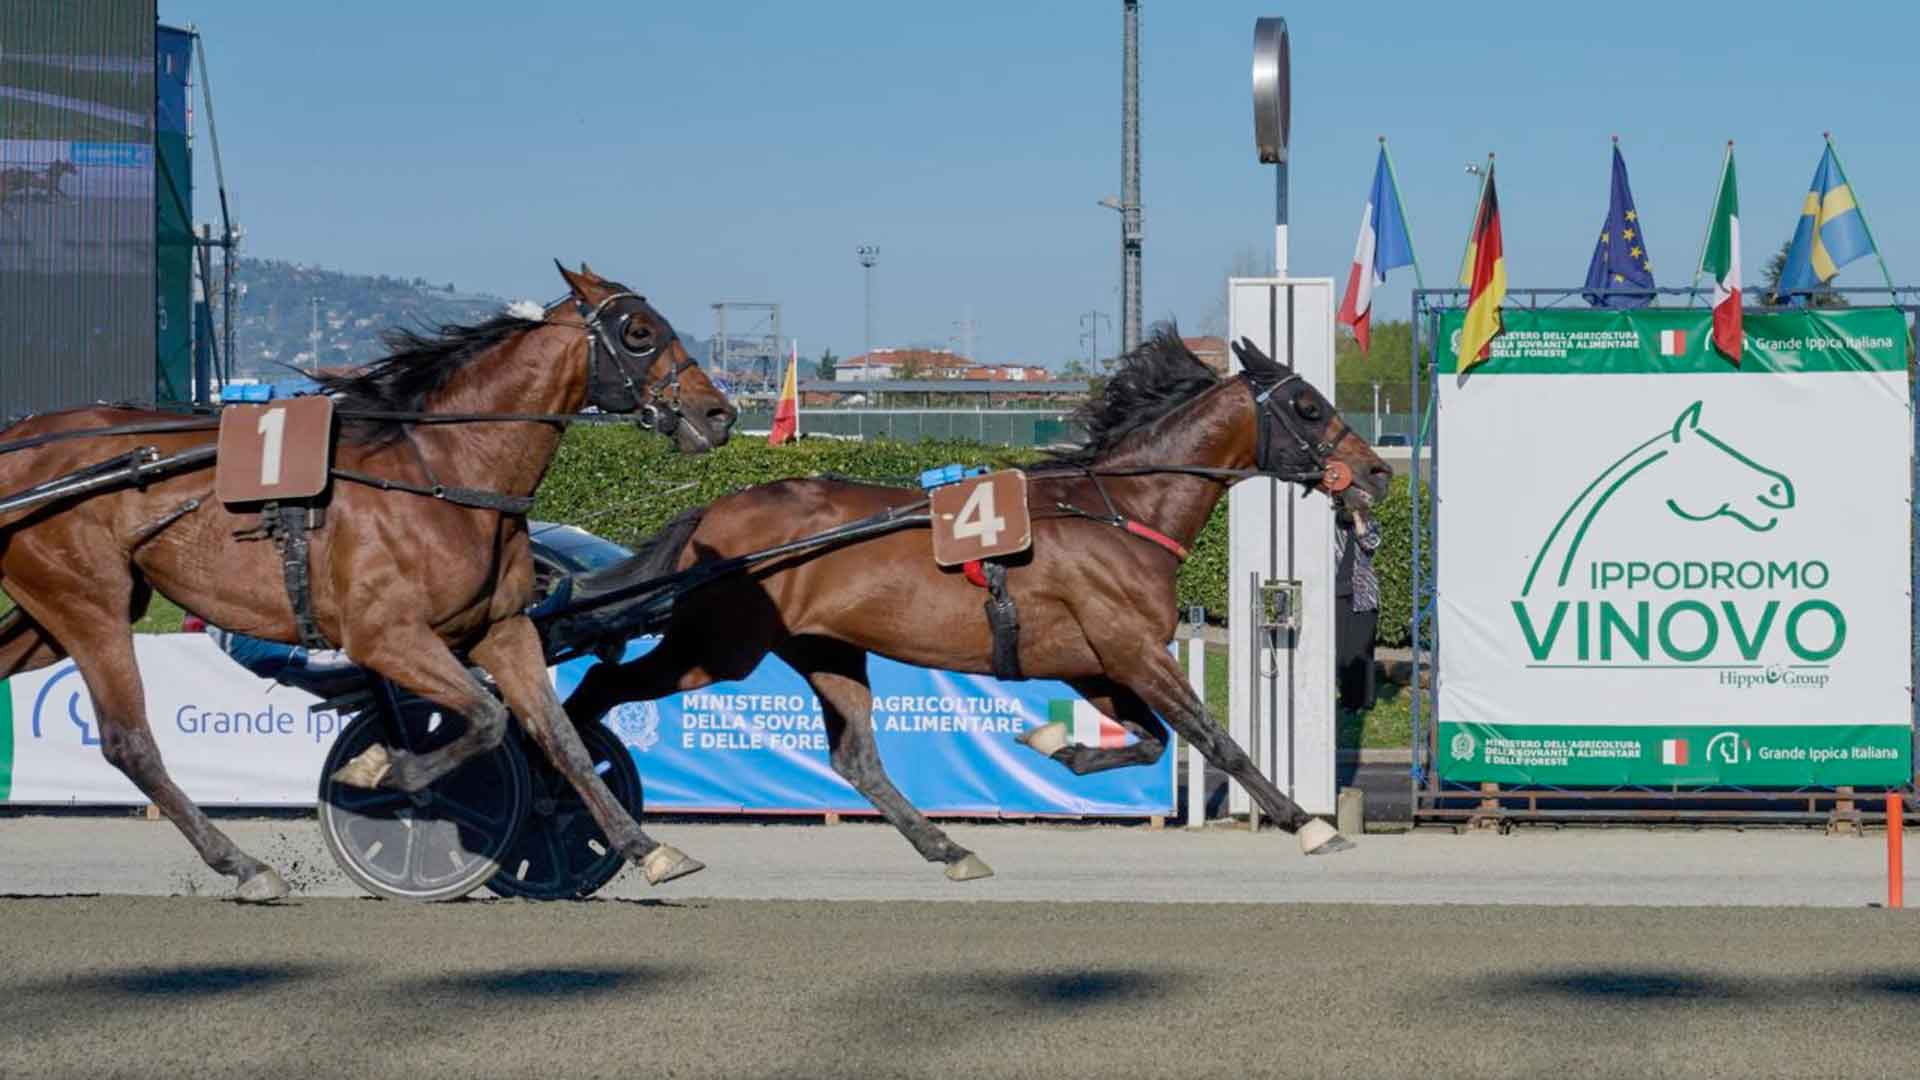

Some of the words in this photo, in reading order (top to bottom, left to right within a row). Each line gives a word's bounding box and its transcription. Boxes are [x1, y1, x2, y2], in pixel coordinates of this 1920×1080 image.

[1543, 331, 1639, 340] DELL'AGRICOLTURA
[1755, 337, 1802, 349] Grande
[1846, 336, 1893, 348] Italiana
[1576, 340, 1640, 349] ALIMENTARE
[1523, 350, 1567, 358] FORESTE
[258, 408, 286, 485] 1
[953, 481, 1006, 547] 4
[1591, 560, 1829, 590] IPPODROMO
[1511, 599, 1847, 662] VINOVO
[683, 695, 805, 711] MINISTERO
[176, 705, 294, 735] Grande
[683, 713, 746, 729] DELLA
[885, 716, 1024, 733] ALIMENTARE
[683, 733, 695, 748] E
[701, 733, 761, 749] DELLE
[769, 734, 830, 750] FORE
[1485, 738, 1541, 748] MINISTERO
[1543, 740, 1641, 748] DELL'AGRICOLTURA
[1485, 756, 1490, 764] E
[1493, 756, 1521, 765] DELLE
[1523, 757, 1568, 766] FORESTE
[1576, 749, 1641, 758] ALIMENTARE
[1759, 746, 1806, 759] Grande
[1809, 746, 1848, 762] Ippica
[1851, 745, 1898, 759] Italiana
